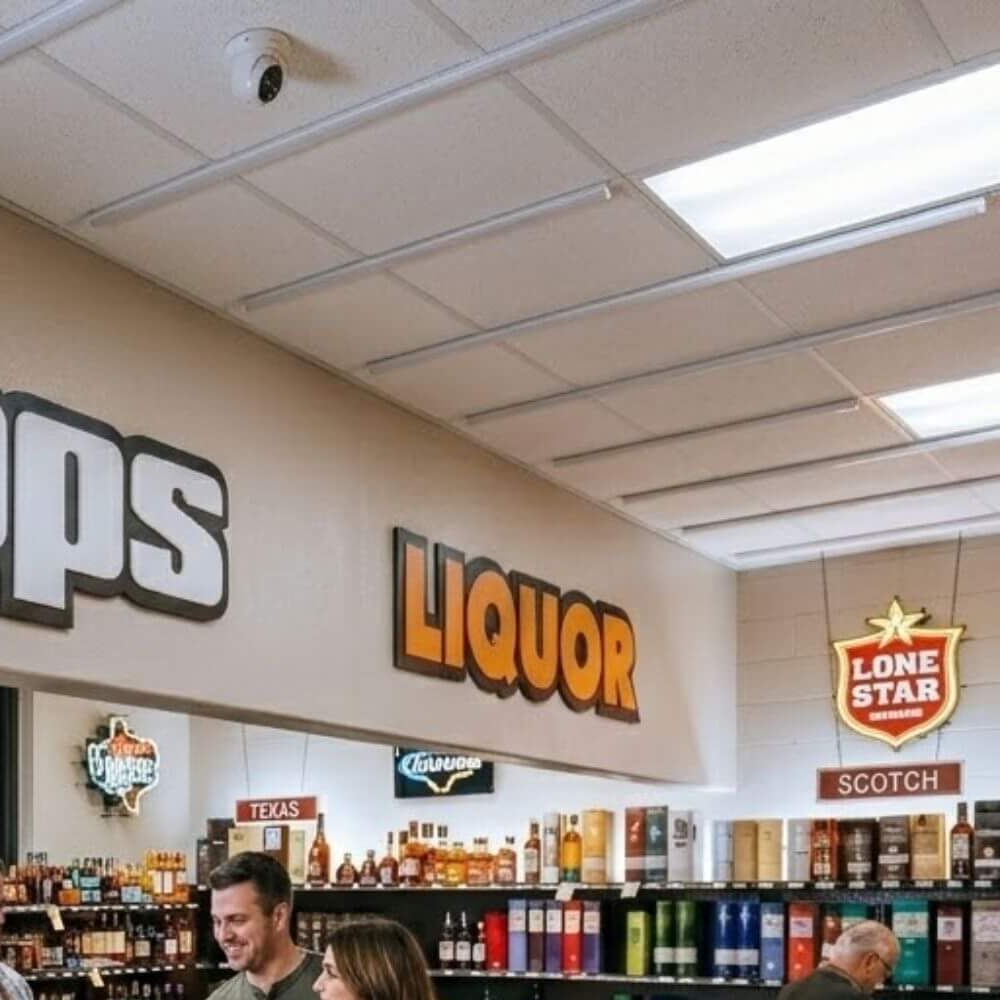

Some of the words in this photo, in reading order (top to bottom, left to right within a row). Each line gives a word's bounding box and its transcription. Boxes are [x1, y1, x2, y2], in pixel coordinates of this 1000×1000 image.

[393, 527, 640, 723] LIQUOR
[852, 650, 939, 681] LONE
[852, 677, 940, 708] STAR
[838, 770, 938, 795] SCOTCH
[250, 801, 300, 819] TEXAS
